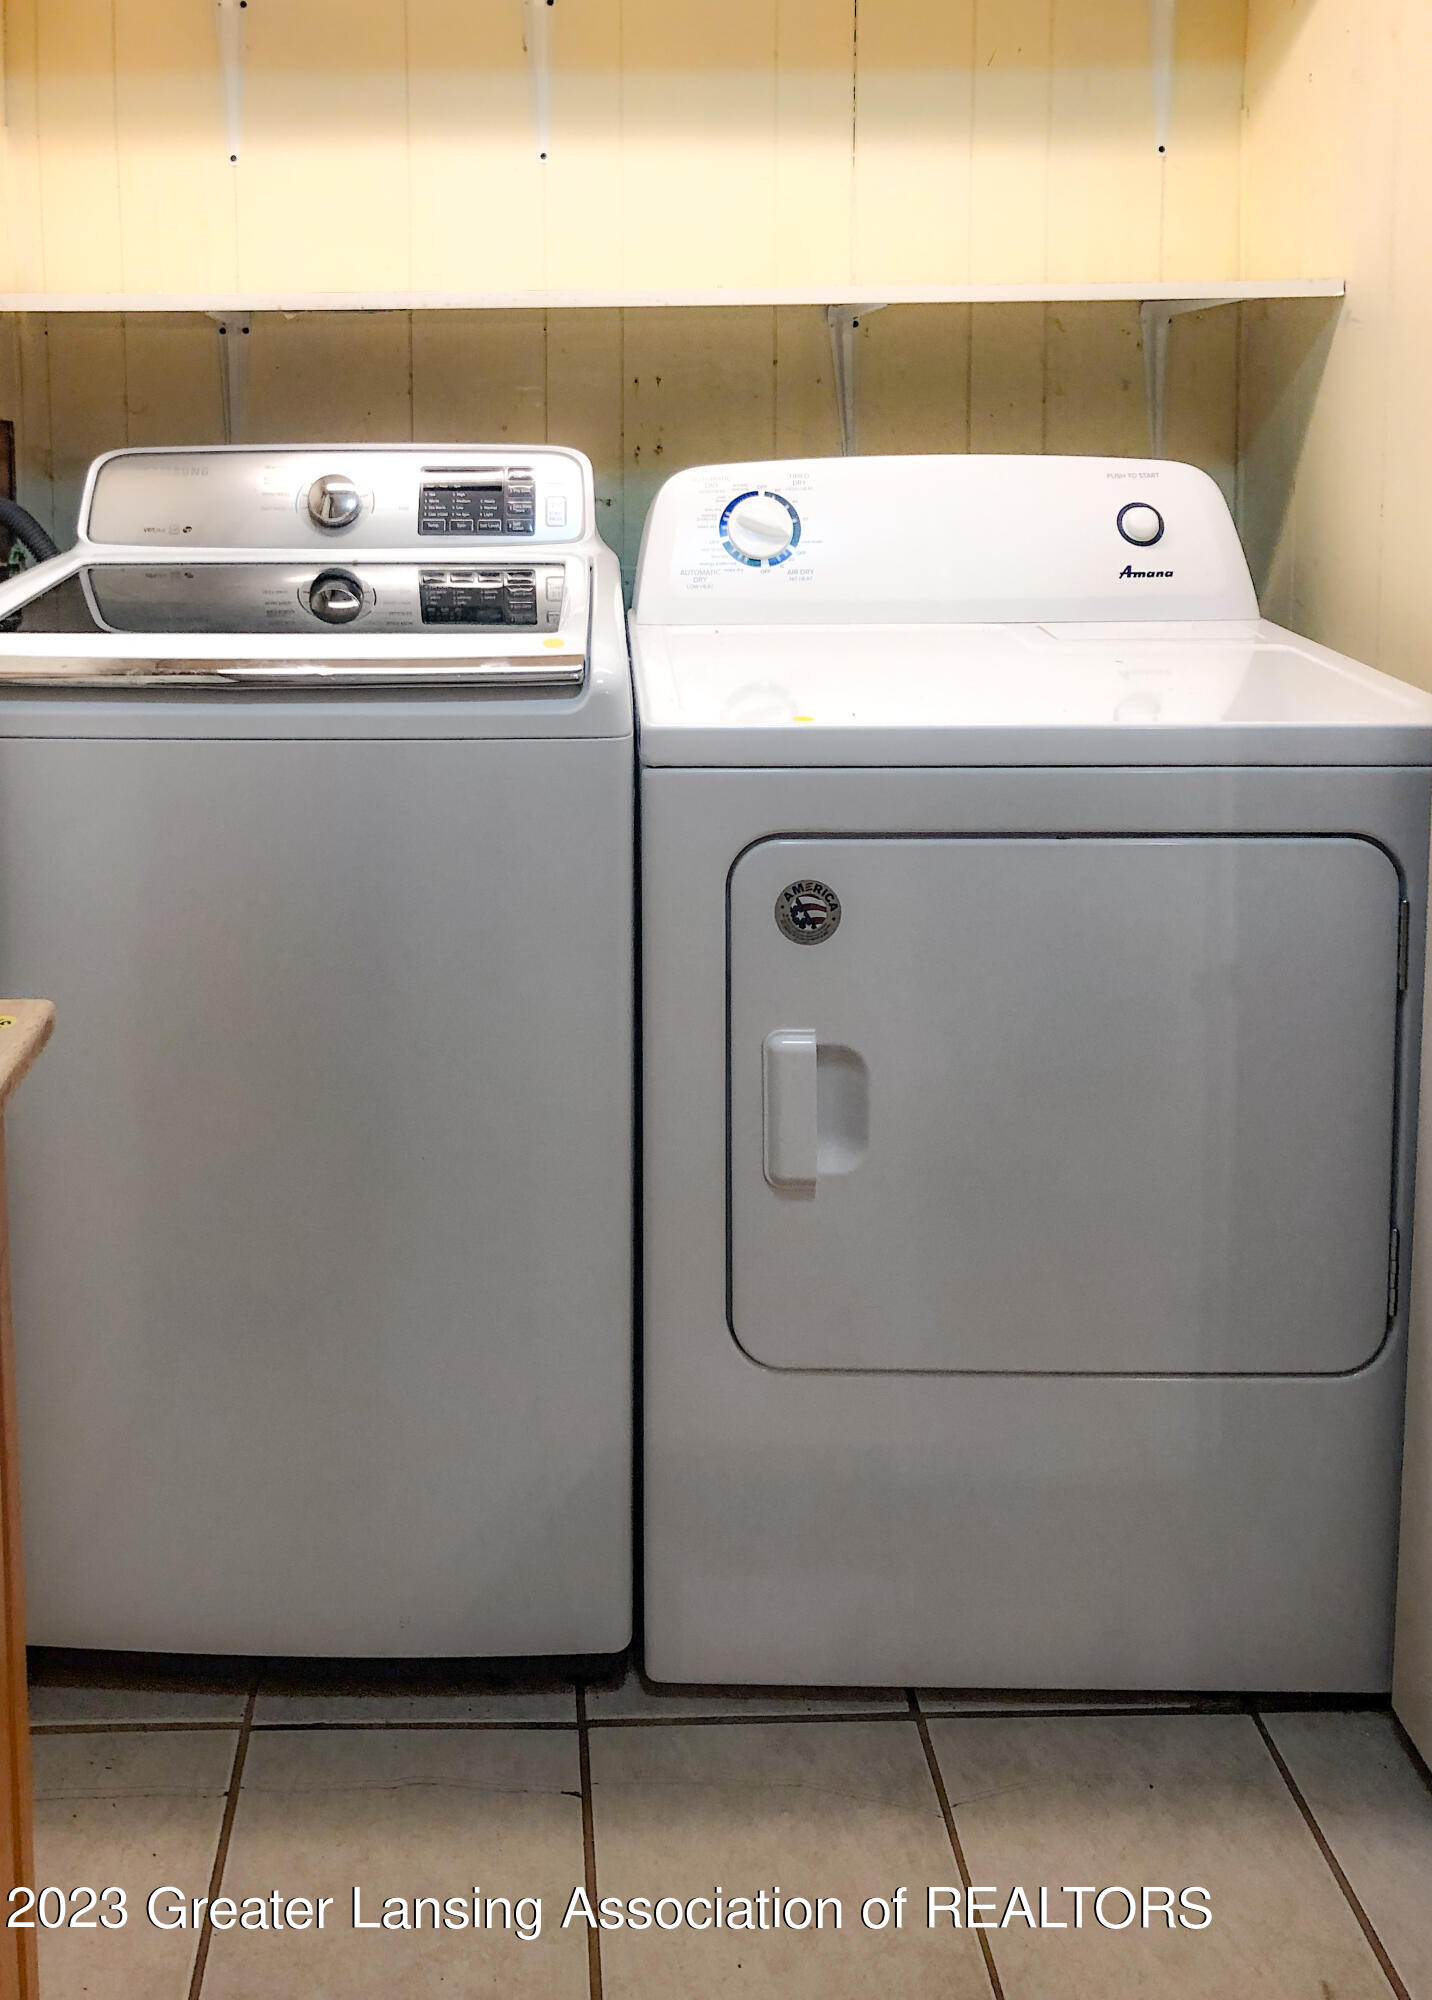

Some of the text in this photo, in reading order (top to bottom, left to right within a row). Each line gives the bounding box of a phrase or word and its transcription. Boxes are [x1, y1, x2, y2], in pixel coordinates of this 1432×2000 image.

[680, 568, 721, 576] AUTOMATIC
[1119, 565, 1174, 579] Amana
[783, 882, 839, 912] AMERICA
